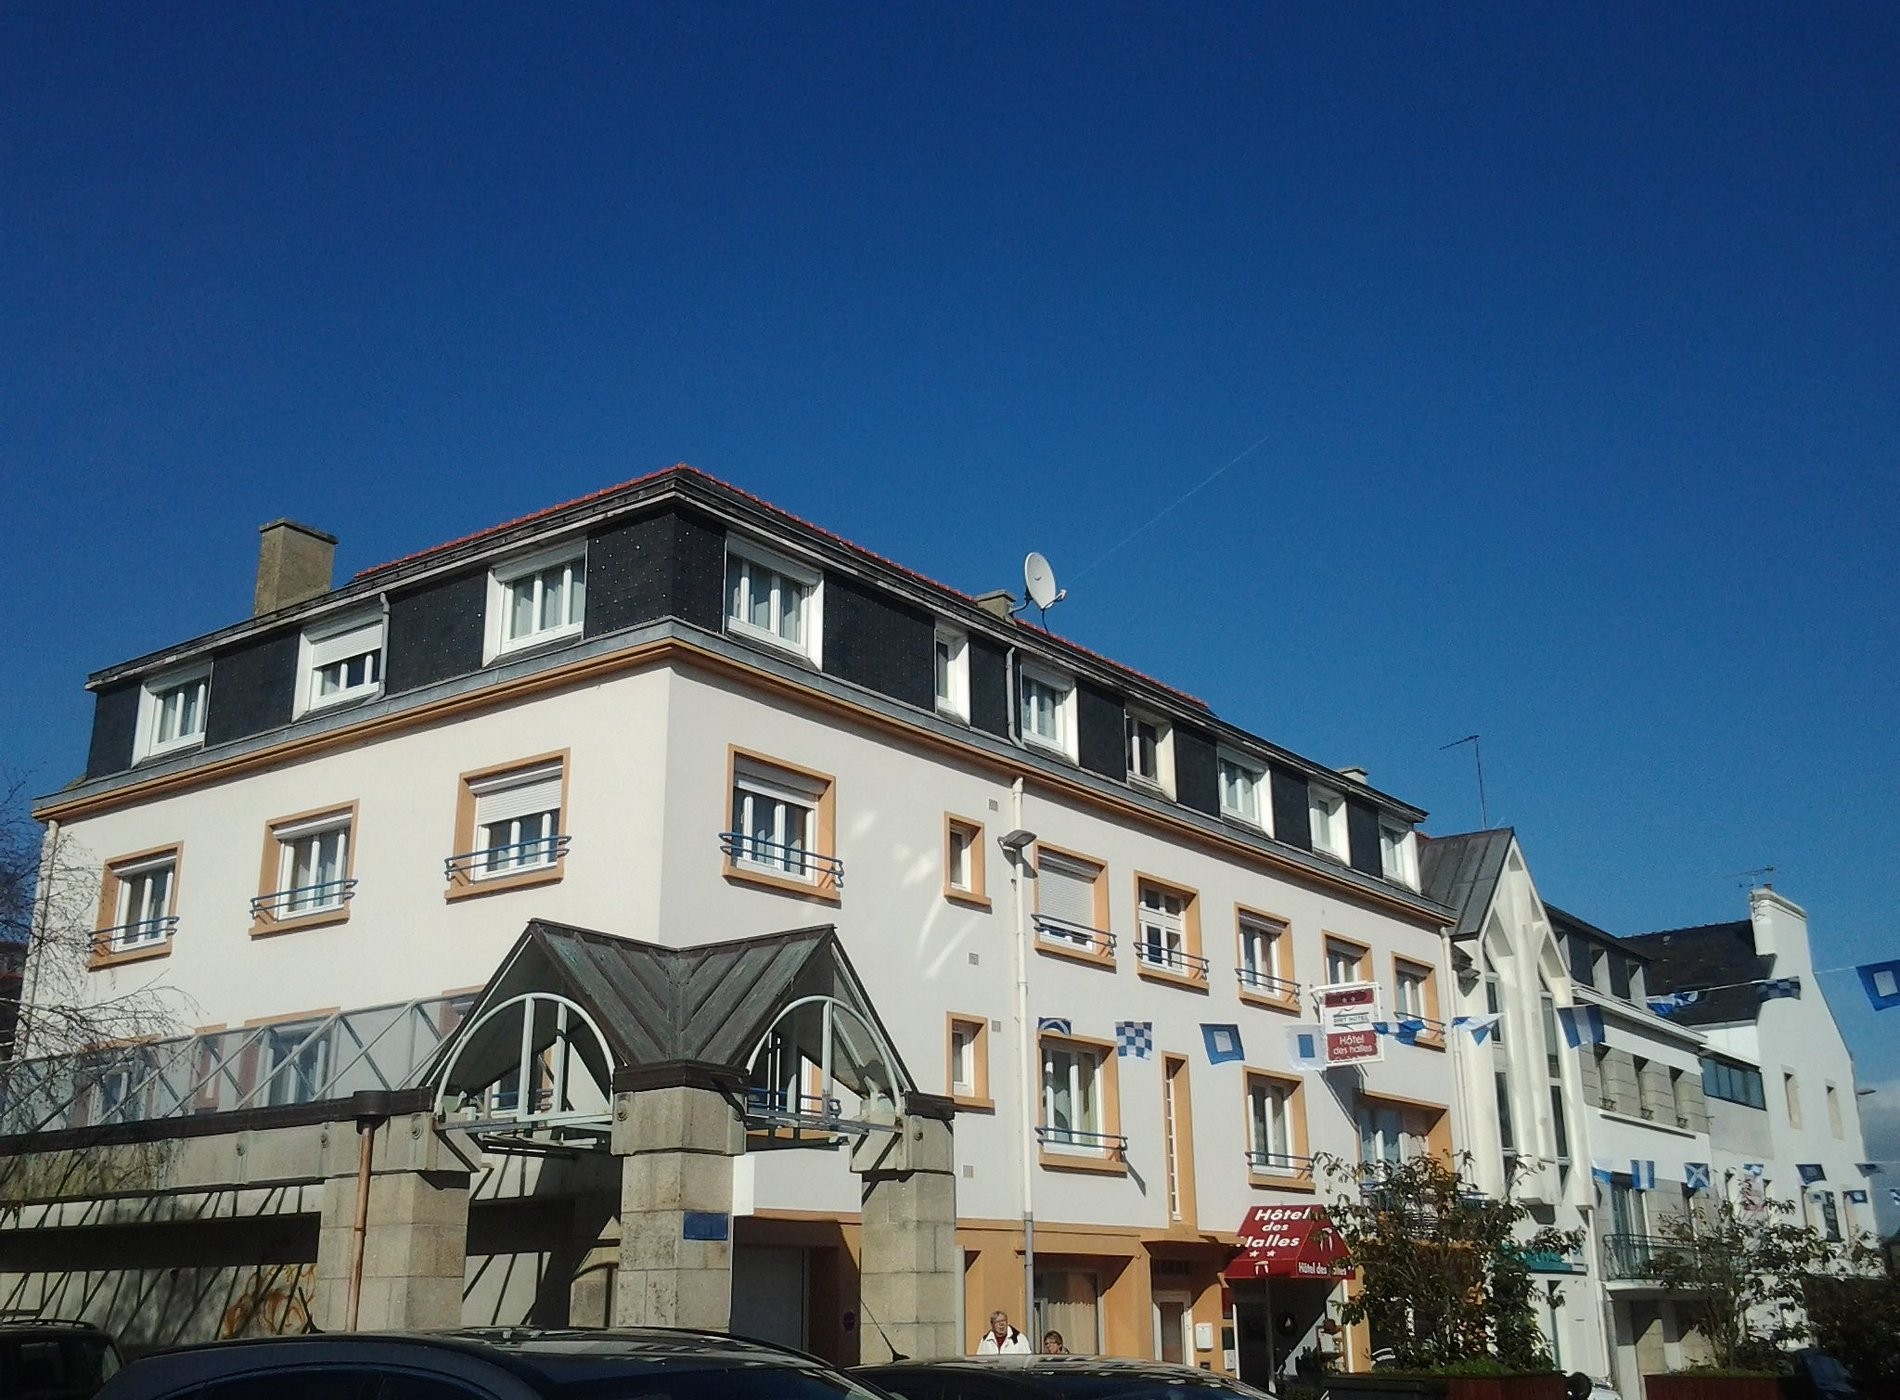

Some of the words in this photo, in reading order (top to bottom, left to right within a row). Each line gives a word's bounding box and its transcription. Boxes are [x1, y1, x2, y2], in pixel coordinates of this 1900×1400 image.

[1339, 1034, 1365, 1045] Hôtel
[1333, 1047, 1348, 1055] des
[1254, 1207, 1311, 1221] Hôtel
[1261, 1221, 1289, 1232] des
